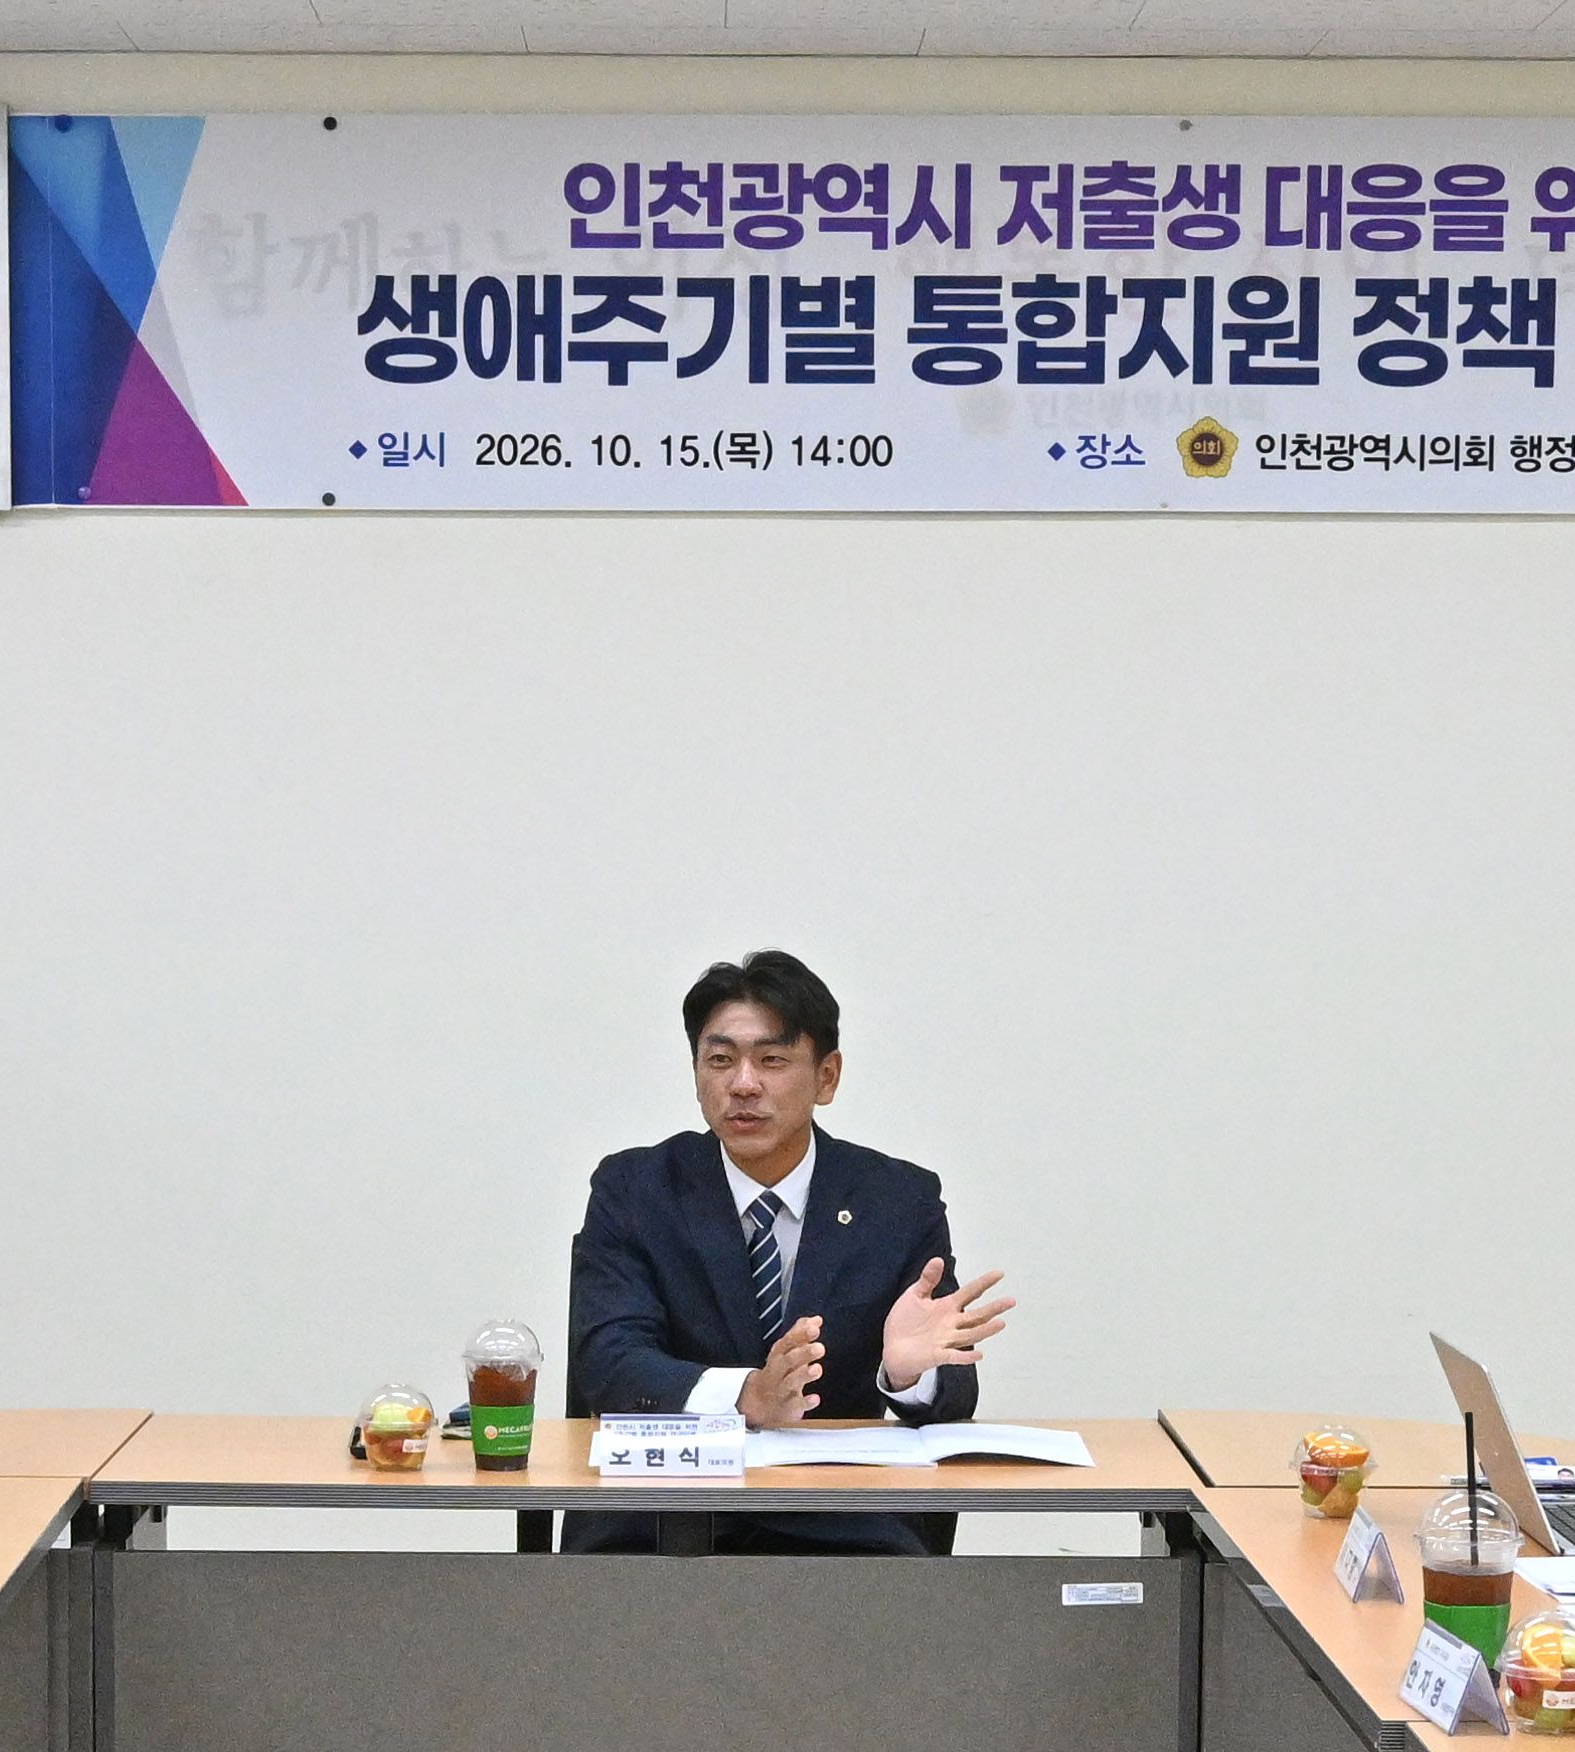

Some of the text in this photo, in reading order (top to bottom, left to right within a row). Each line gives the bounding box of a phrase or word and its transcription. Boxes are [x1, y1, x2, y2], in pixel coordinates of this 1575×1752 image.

[564, 162, 971, 250] 인천광역시
[998, 161, 1241, 250] 저출생
[1265, 164, 1508, 251] 대응을
[358, 275, 875, 385] 생애주기별
[907, 274, 1320, 385] 통합지원
[1354, 276, 1556, 388] 정책
[378, 431, 892, 470] 일시 2026. 10. 15.(목) 14:00
[1077, 434, 1145, 469] 장소
[1193, 440, 1220, 455] 의회
[1256, 434, 1494, 471] 인천광역시의회
